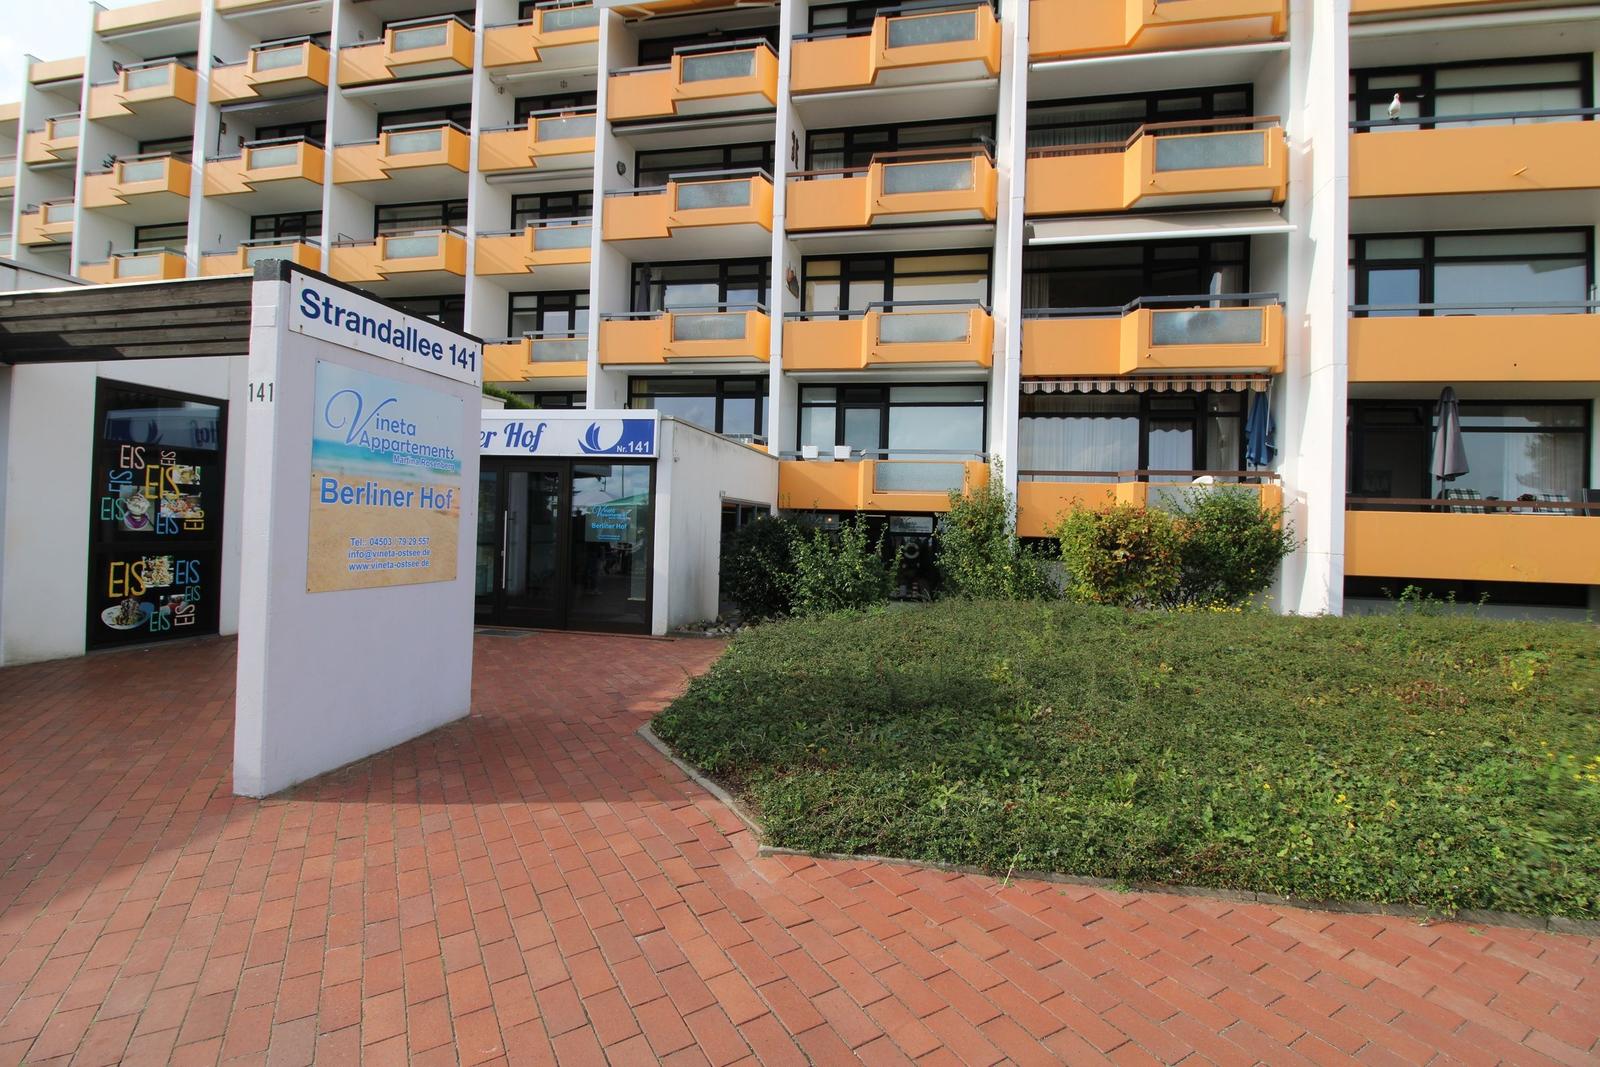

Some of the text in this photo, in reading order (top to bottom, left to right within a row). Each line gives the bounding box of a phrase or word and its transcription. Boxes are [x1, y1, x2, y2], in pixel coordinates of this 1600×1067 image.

[300, 288, 477, 372] Strandallee 141
[249, 382, 274, 402] 141
[325, 389, 416, 444] Vineta
[359, 430, 455, 460] Appartements
[503, 422, 548, 453] Hof
[616, 440, 650, 453] Nr. 141
[120, 444, 146, 470] EIS
[160, 450, 177, 466] EIS
[144, 464, 181, 500] EIS
[320, 477, 453, 510] Berliner Hof
[100, 496, 125, 521] EIS
[156, 512, 179, 535] EIS
[108, 560, 147, 598] EIS
[175, 559, 201, 585] EIS
[184, 585, 201, 602] EIS
[149, 611, 171, 632] EIS
[174, 603, 196, 626] EIS
